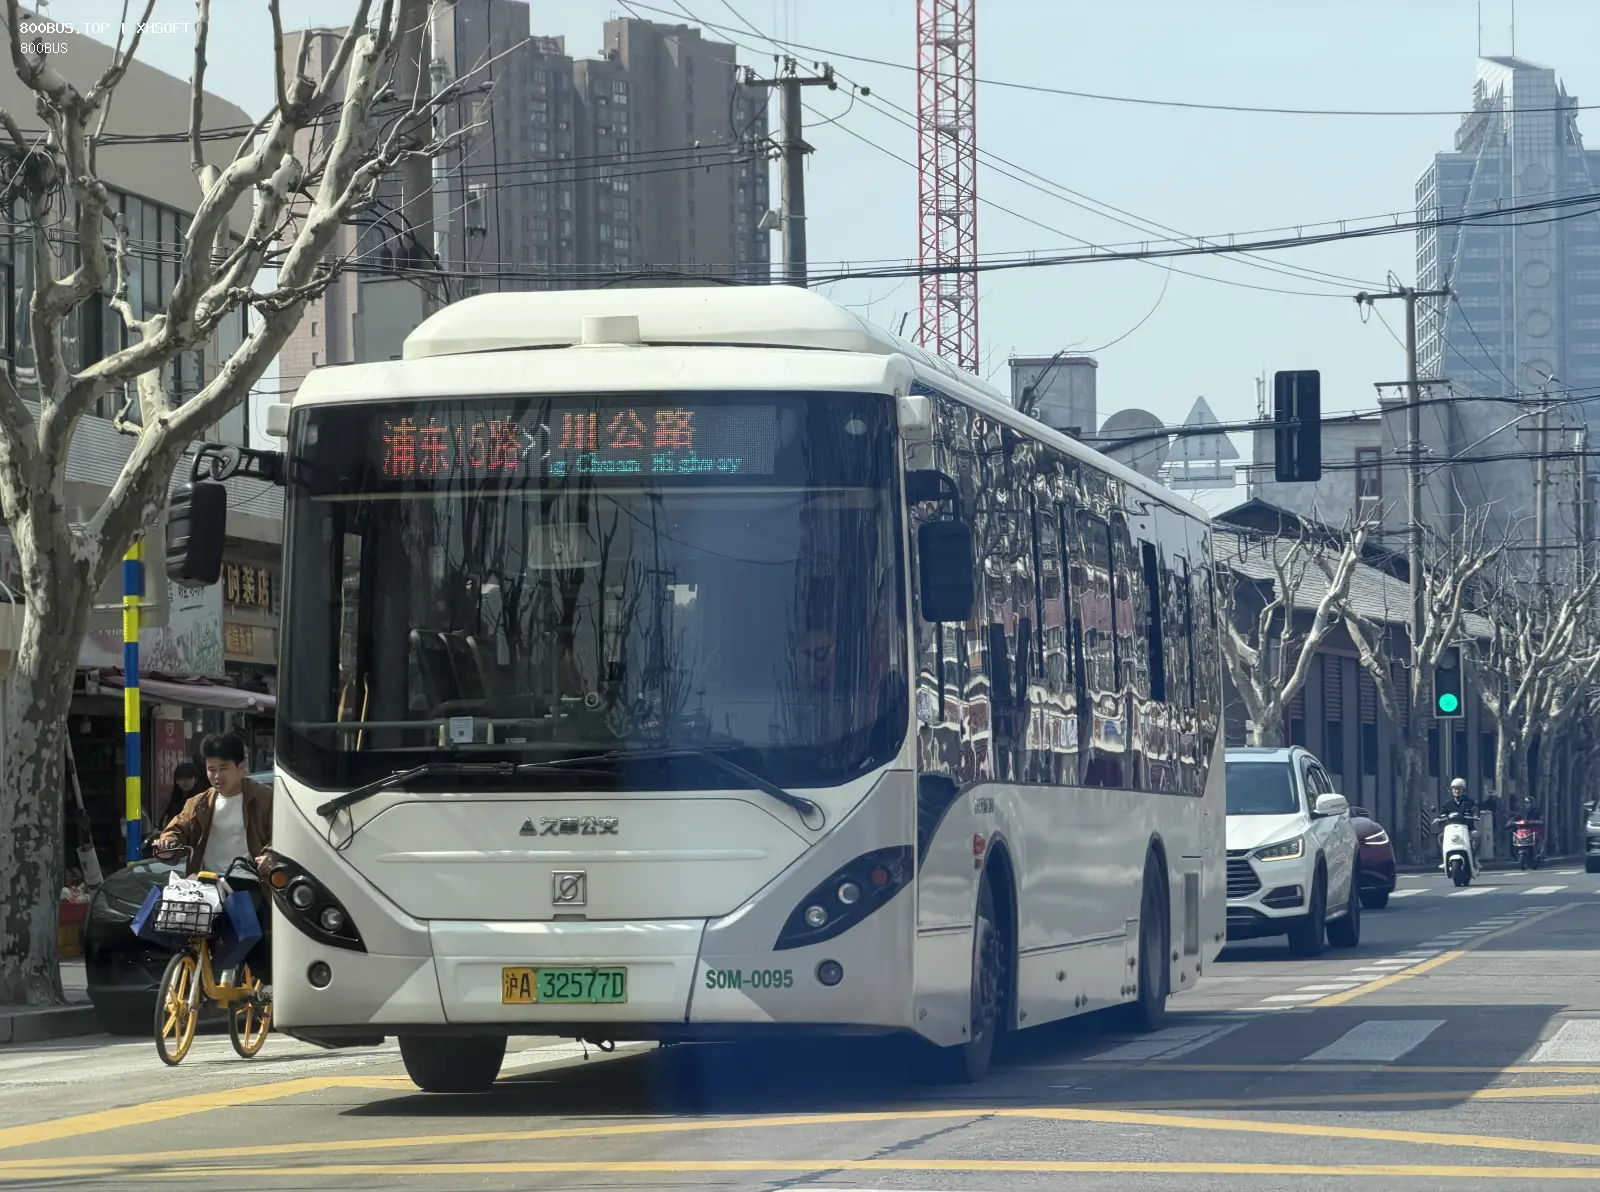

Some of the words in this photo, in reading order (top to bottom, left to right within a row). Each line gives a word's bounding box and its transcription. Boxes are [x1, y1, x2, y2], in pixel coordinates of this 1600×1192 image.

[383, 415, 521, 476] 浦东15路
[558, 406, 697, 450] 川公路
[221, 563, 270, 606] 时装店
[539, 815, 619, 836] 久事公交
[505, 971, 531, 998] 沪A
[543, 973, 624, 998] 32577D
